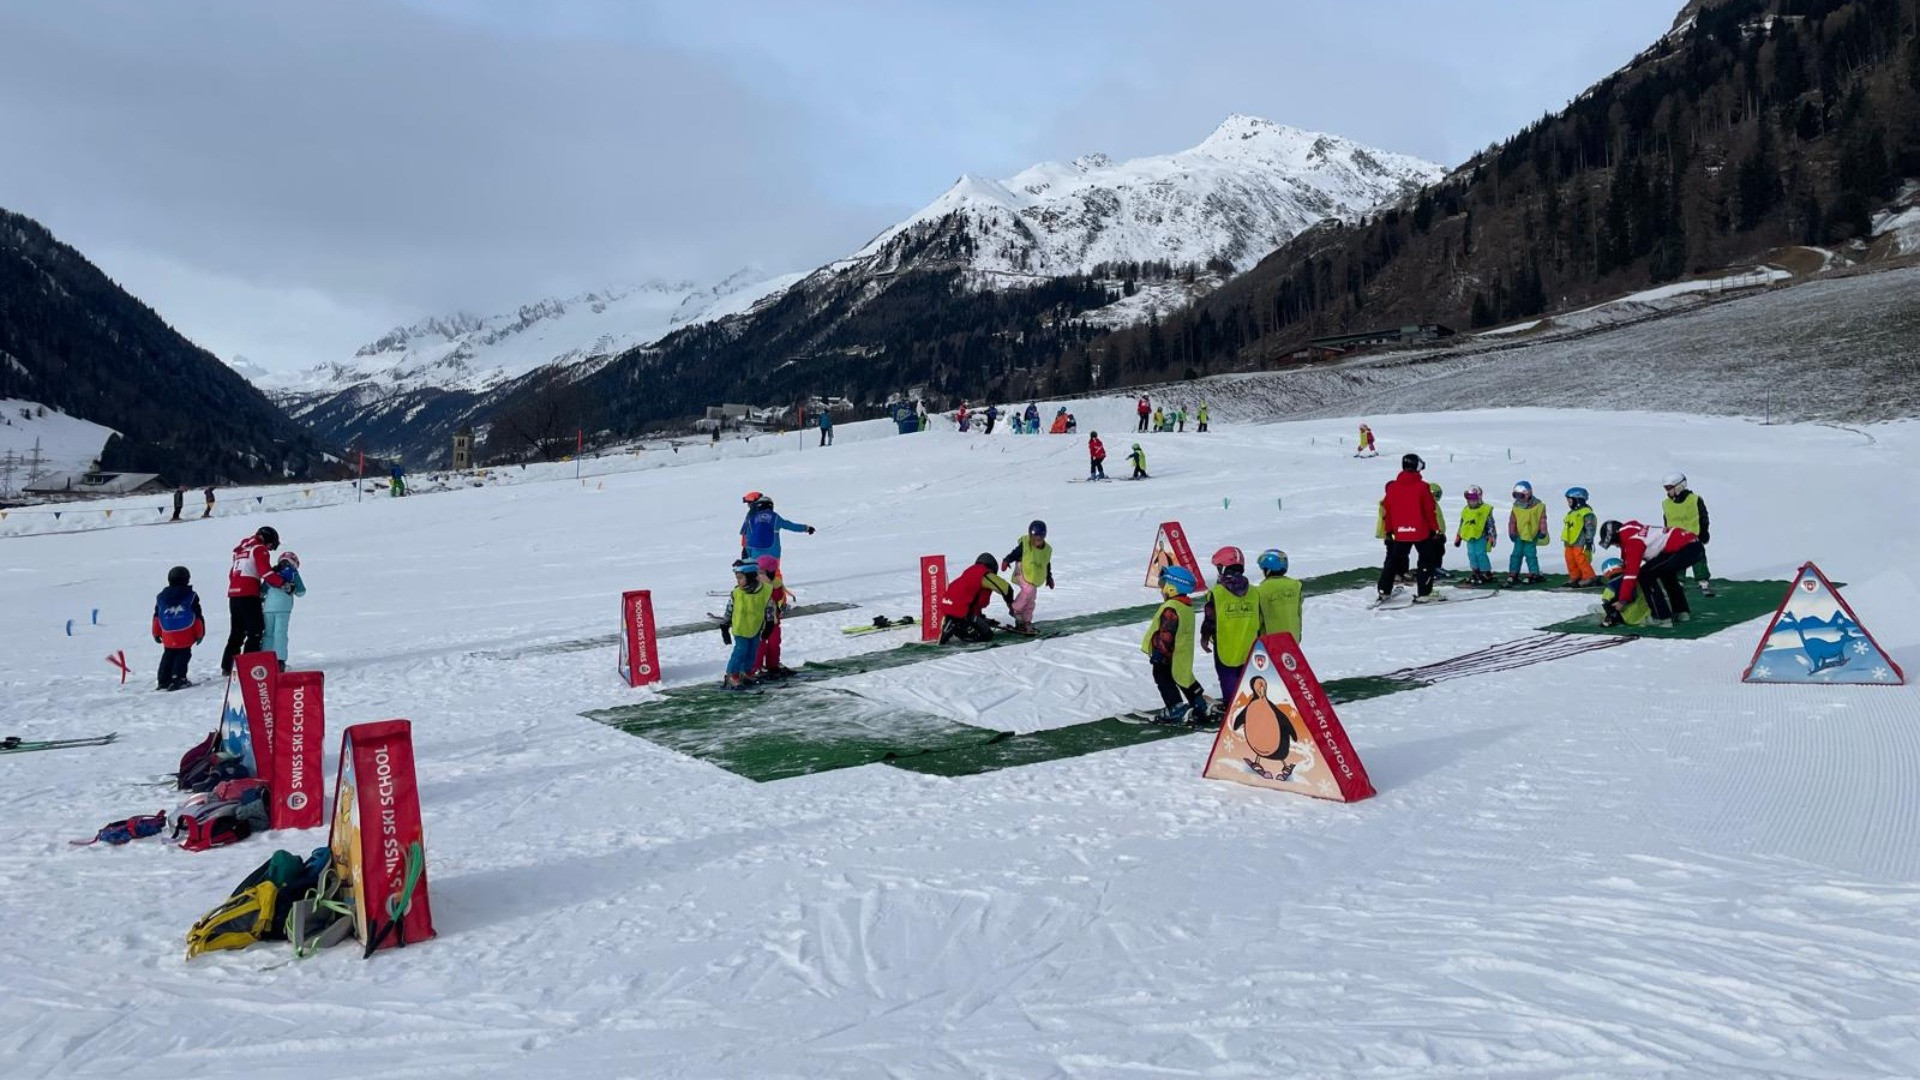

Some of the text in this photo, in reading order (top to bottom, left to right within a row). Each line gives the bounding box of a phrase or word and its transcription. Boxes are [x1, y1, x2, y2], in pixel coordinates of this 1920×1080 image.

[257, 682, 271, 711] SWISS
[263, 712, 274, 728] SKI
[292, 686, 304, 788] SWISS SKI SCHOOL
[1293, 673, 1353, 779] SWISS SKI SCHOOL
[375, 744, 394, 806] SCHOOL
[383, 810, 396, 836] SKI
